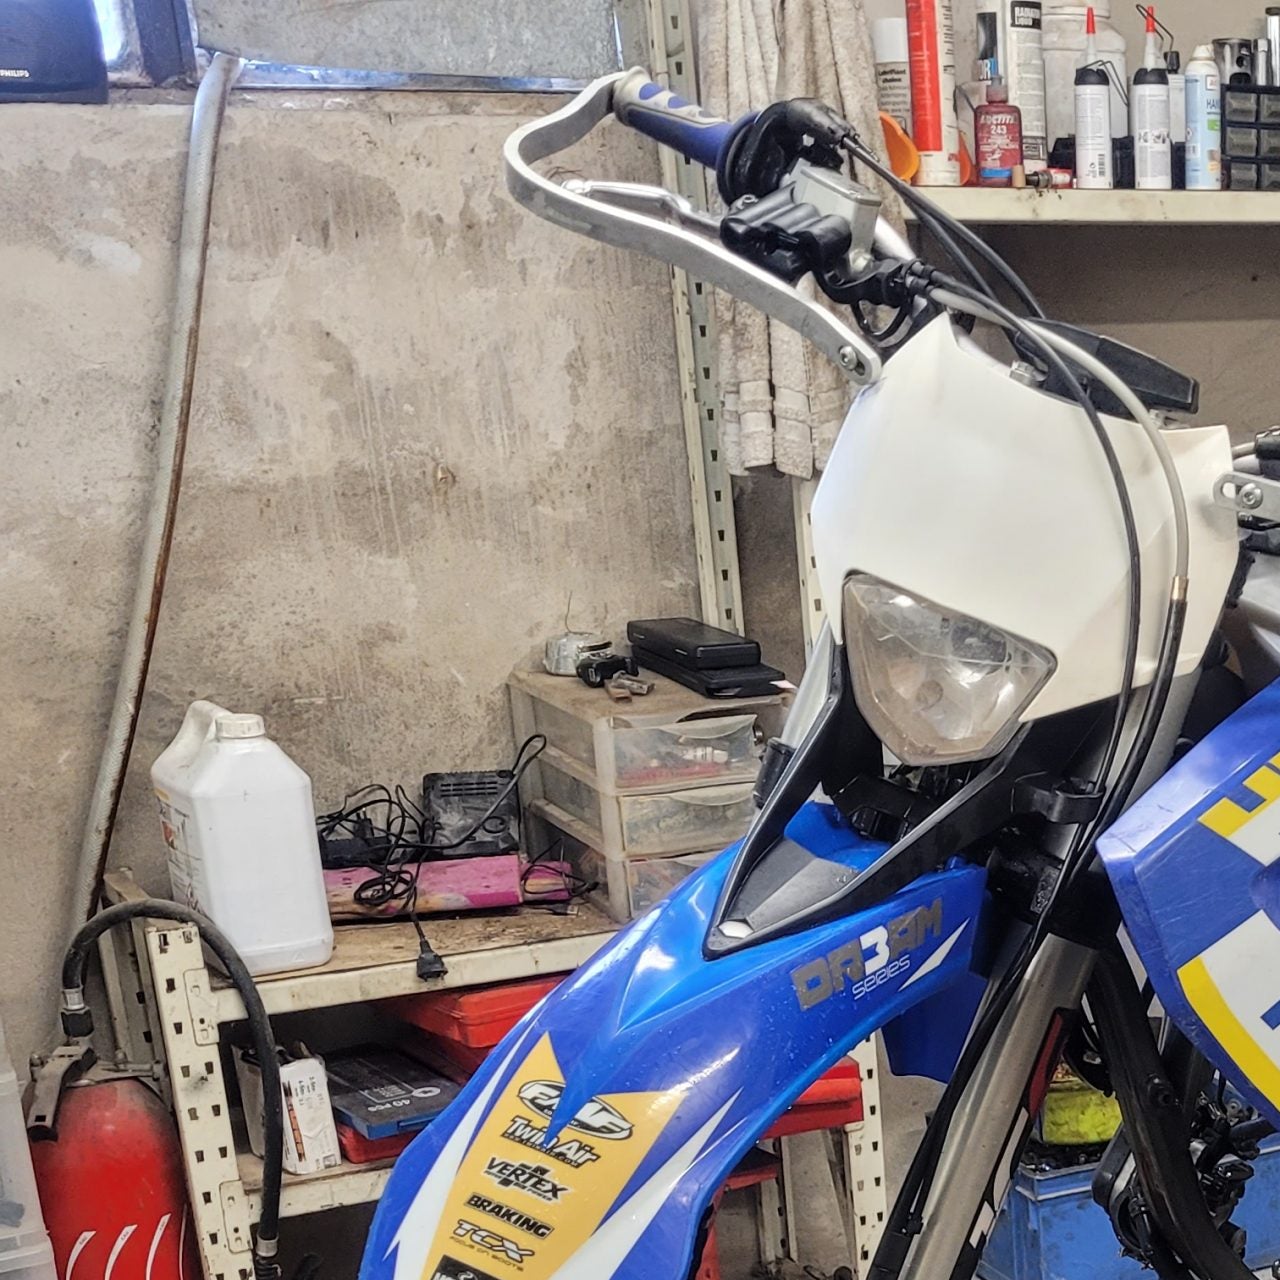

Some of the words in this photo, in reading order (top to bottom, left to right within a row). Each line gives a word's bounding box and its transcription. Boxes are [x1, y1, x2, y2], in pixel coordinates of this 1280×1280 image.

[990, 124, 1007, 135] 243
[551, 1140, 602, 1165] Air
[485, 1156, 568, 1200] VERTEX
[467, 1194, 553, 1238] BRAKING
[452, 1218, 535, 1264] TCX
